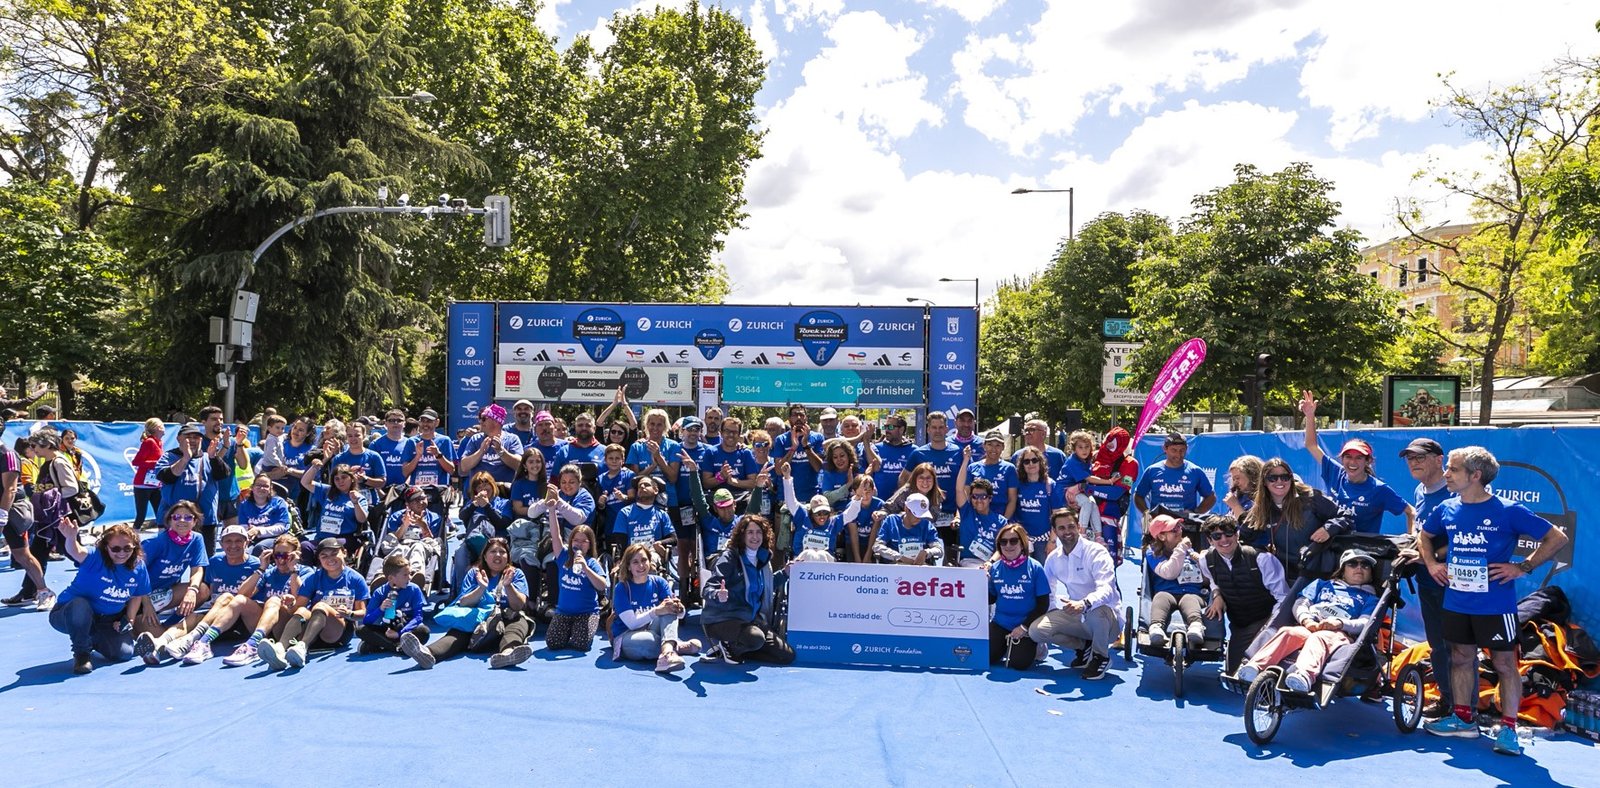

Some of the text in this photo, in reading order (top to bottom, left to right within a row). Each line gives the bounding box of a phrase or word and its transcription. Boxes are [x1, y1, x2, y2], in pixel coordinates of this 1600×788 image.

[527, 318, 564, 328] ZURICH
[655, 320, 692, 330] ZURICH
[746, 321, 784, 331] ZURICH
[877, 322, 915, 332] ZURICH
[457, 359, 484, 367] ZURICH
[938, 363, 965, 371] ZURICH
[1153, 349, 1200, 405] aefat
[577, 380, 606, 388] 06:22:46
[735, 385, 761, 394] 33644
[841, 385, 915, 399] 1€ por finisher
[1495, 488, 1541, 504] ZURICH
[1458, 558, 1481, 566] ZURICH
[799, 571, 889, 584] Z Zurich Foundation
[1454, 567, 1478, 578] 10489
[856, 585, 889, 596] dona a:
[897, 577, 966, 599] aefat
[828, 611, 883, 621] La cantidad de:
[864, 646, 891, 654] ZURICH
[893, 646, 923, 656] Foundation
